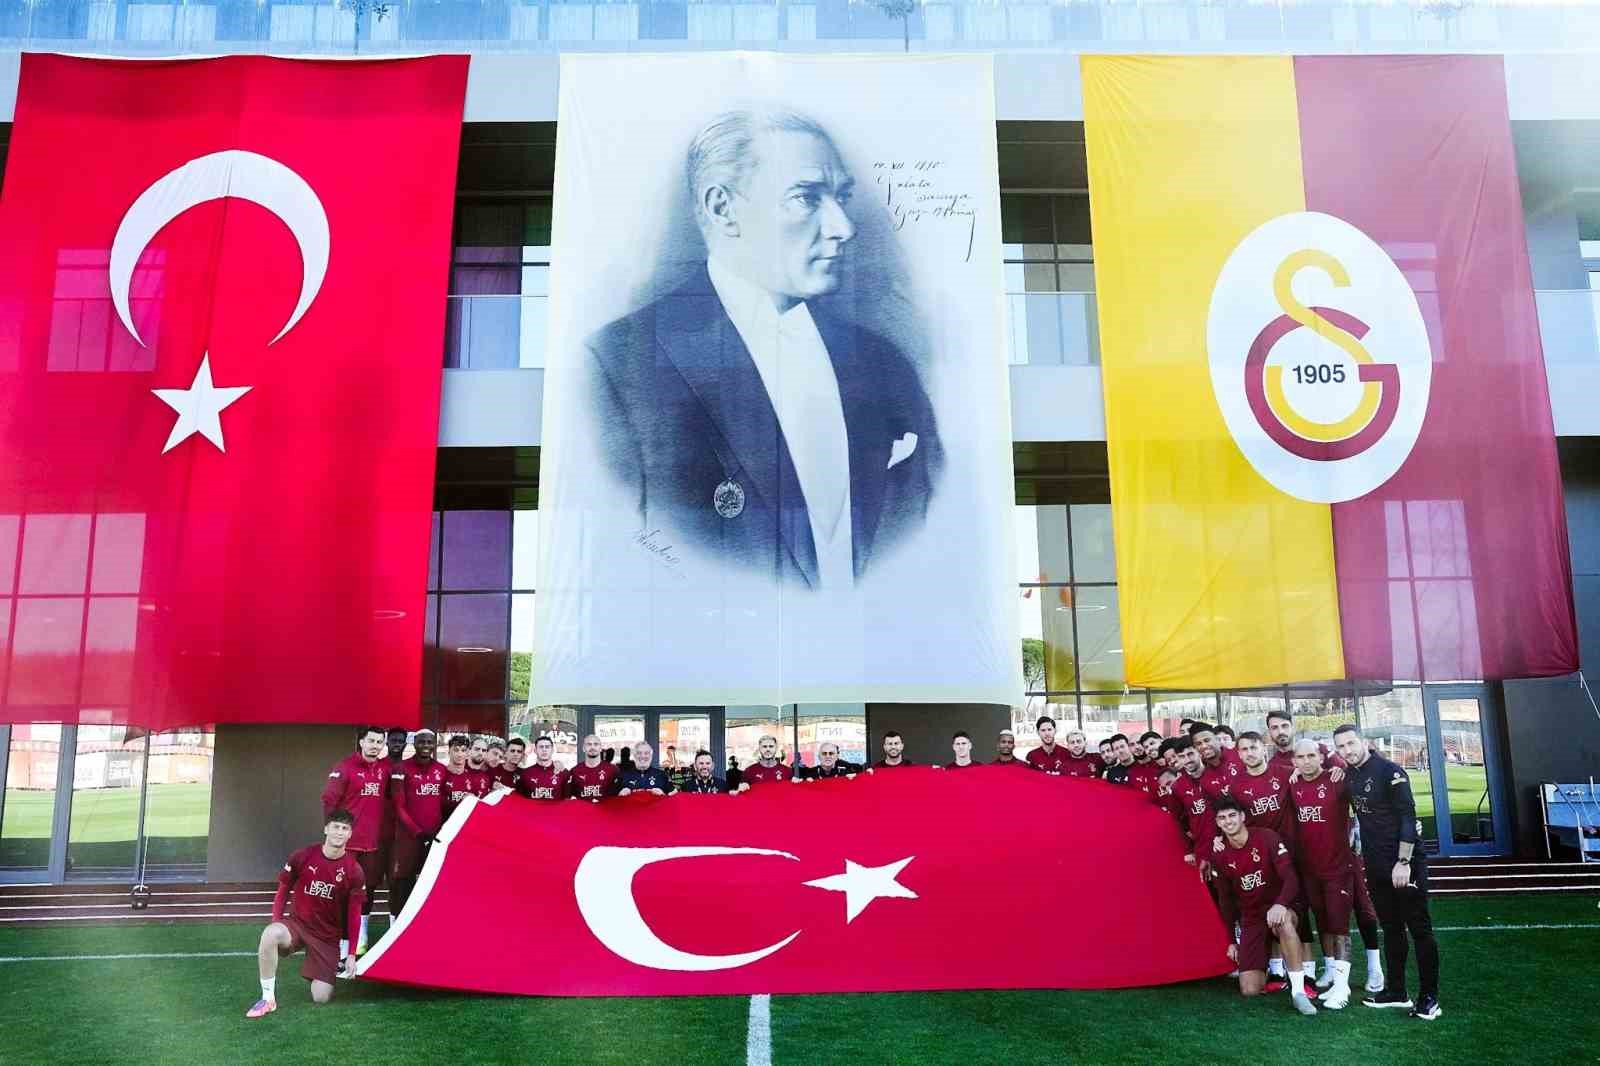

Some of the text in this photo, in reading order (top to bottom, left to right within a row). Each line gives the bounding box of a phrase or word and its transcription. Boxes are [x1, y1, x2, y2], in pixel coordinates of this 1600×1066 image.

[1292, 364, 1346, 384] 1905
[1253, 794, 1279, 809] NEXT
[1250, 803, 1281, 816] LEVEL
[1300, 806, 1323, 815] NEXT
[1298, 813, 1327, 822] LEVEL
